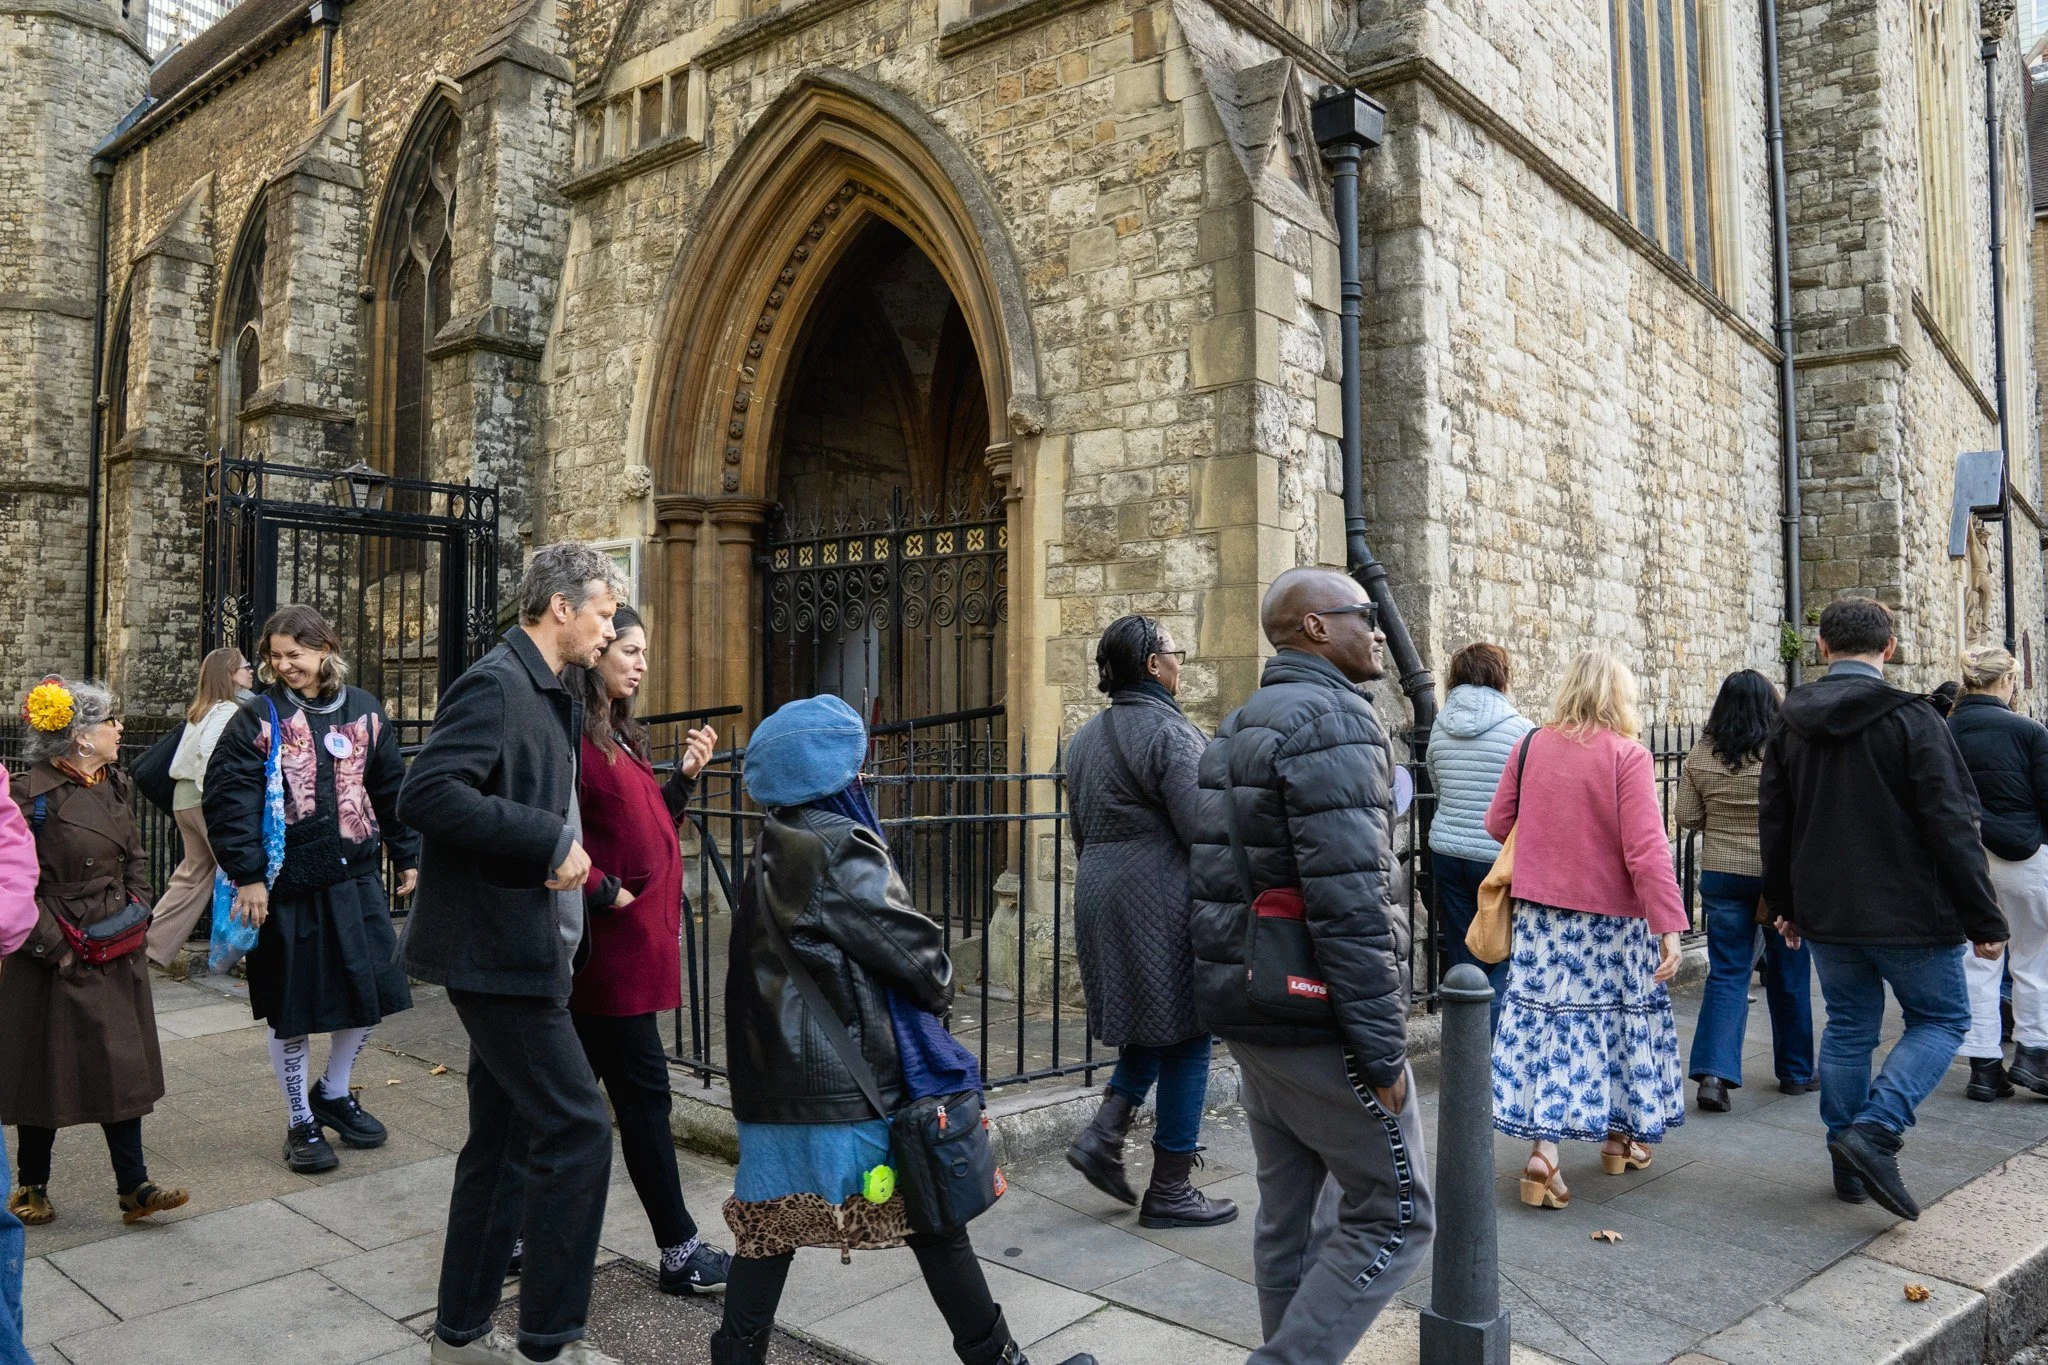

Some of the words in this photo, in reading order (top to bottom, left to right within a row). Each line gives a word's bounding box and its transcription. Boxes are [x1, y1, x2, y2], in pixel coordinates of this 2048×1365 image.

[284, 1039, 304, 1054] to
[284, 1054, 304, 1072] be
[285, 1074, 306, 1112] stared
